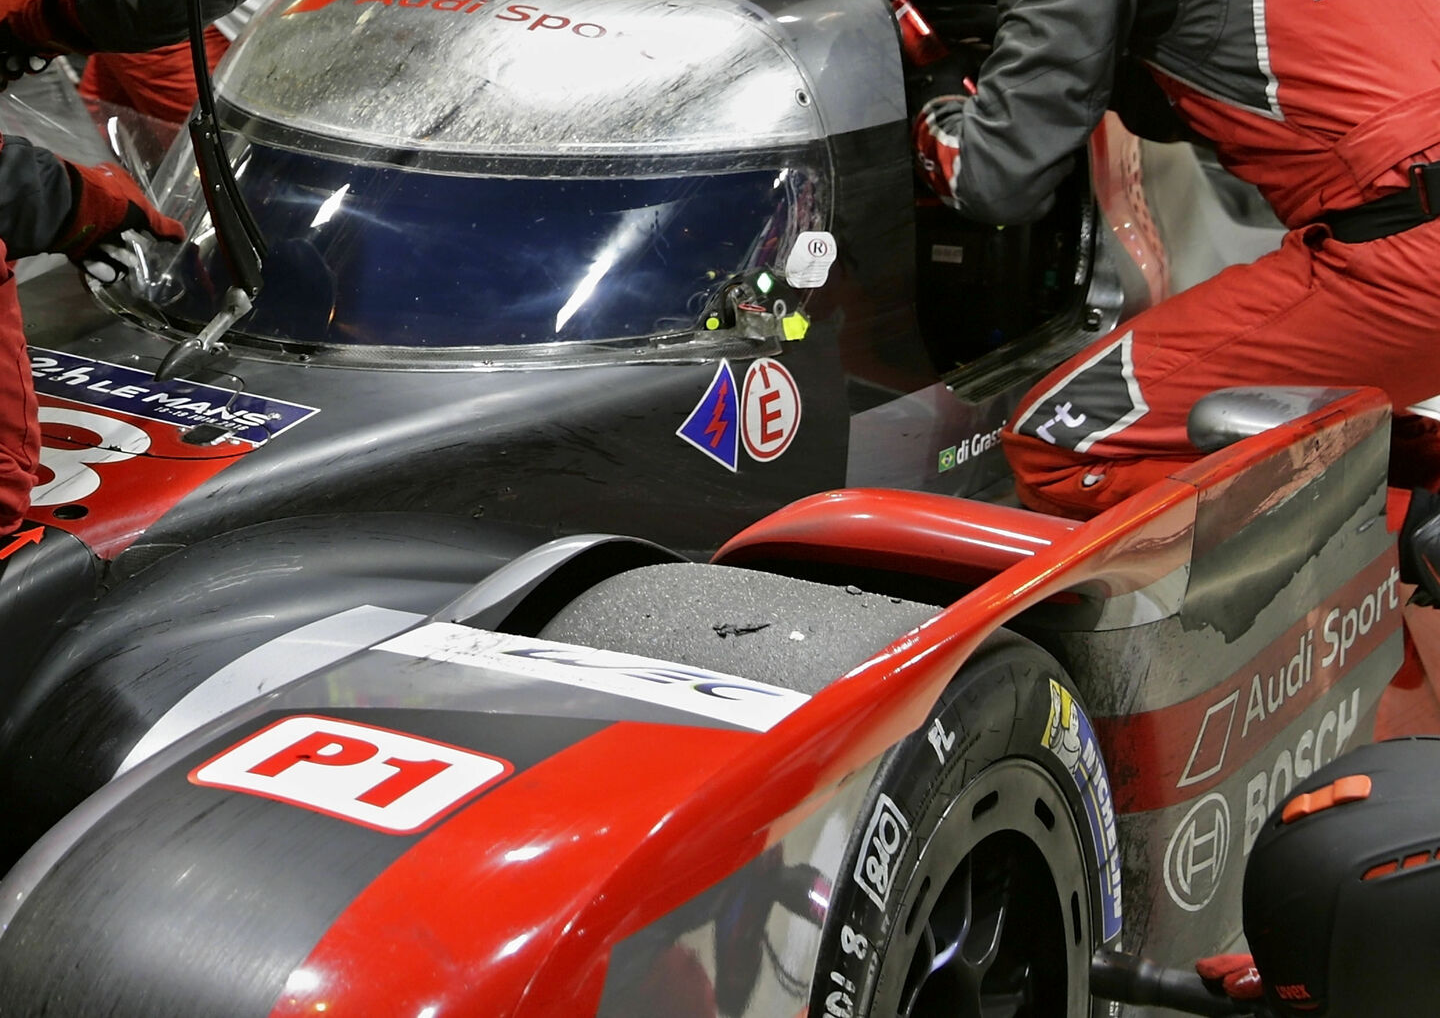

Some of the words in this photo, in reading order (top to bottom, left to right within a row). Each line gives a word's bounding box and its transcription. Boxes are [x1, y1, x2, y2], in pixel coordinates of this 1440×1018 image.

[86, 380, 151, 399] LE
[141, 392, 270, 428] MANS
[759, 390, 783, 445] E
[956, 439, 969, 465] di
[1241, 629, 1314, 739] Audi
[1321, 567, 1401, 668] Sport
[246, 731, 453, 808] P1
[1243, 687, 1361, 856] BOSCH
[1082, 737, 1123, 919] MICHELIN
